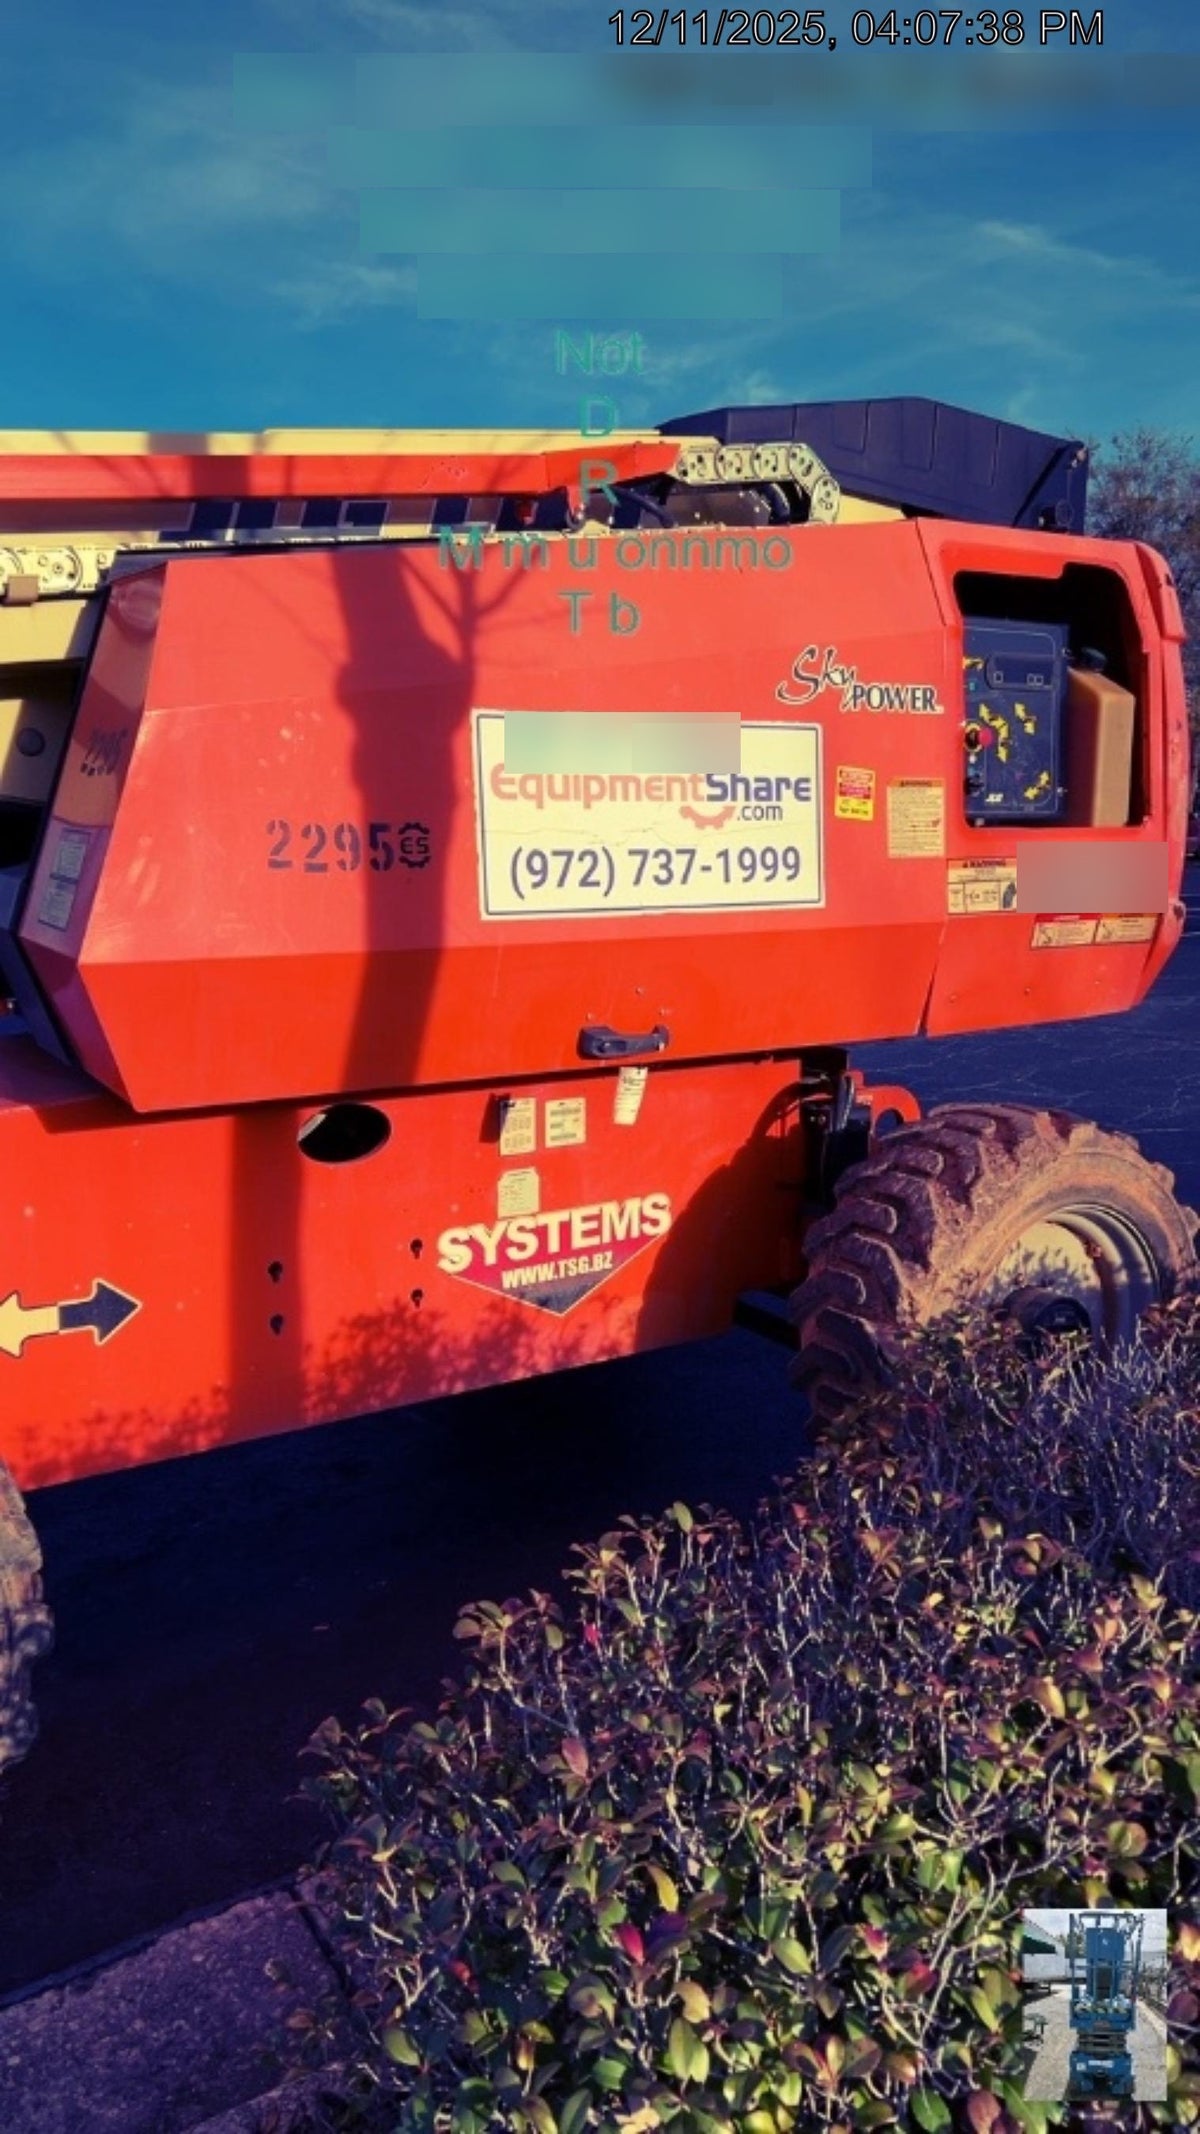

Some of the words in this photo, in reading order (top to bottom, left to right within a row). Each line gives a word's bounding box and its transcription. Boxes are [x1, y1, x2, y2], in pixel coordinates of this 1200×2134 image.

[776, 644, 857, 713] Sky
[851, 684, 942, 714] POWER
[490, 763, 812, 809] EquipmentShare
[736, 804, 783, 822] .com
[266, 819, 395, 873] 2295
[510, 845, 616, 899] (972)
[627, 844, 801, 887] 737-1999
[437, 1191, 673, 1275] SYSTEMS
[501, 1250, 614, 1289] WWW.TSG.BZ
